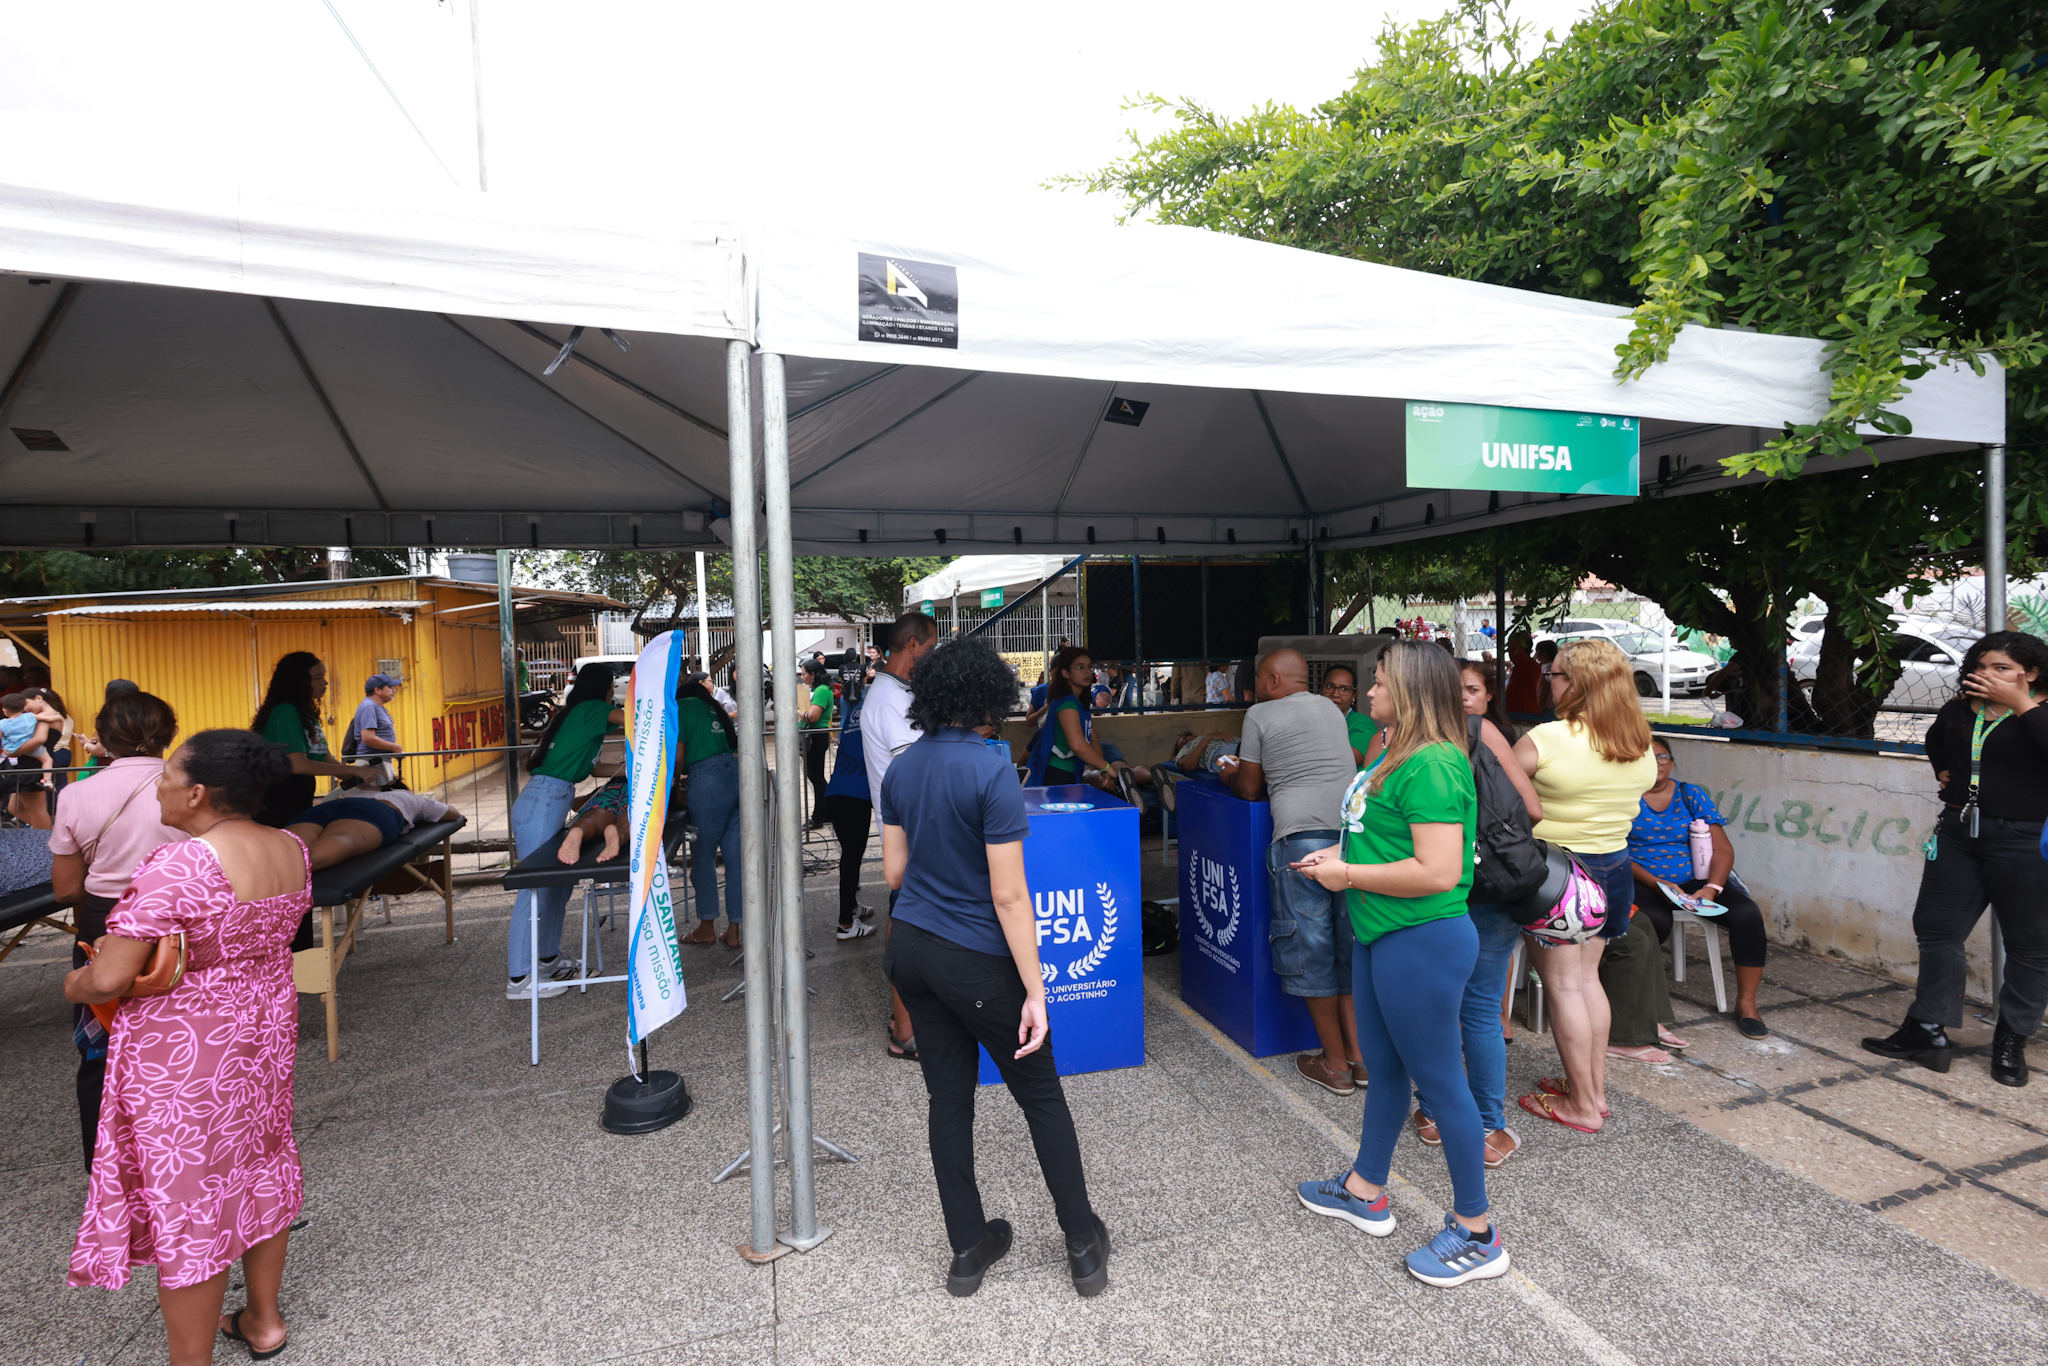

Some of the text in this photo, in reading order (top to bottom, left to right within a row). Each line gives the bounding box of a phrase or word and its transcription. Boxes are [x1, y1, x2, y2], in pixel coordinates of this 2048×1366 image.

[861, 314, 893, 322] GERADORES
[920, 319, 955, 328] SONORIZAÇÃO
[861, 320, 893, 328] ILUMINAÇÃO
[896, 322, 916, 330] TENDAS
[918, 324, 939, 332] STANDS
[1412, 405, 1445, 418] ação
[1482, 442, 1572, 471] UNIFSA
[432, 710, 477, 767] PLANET
[637, 698, 654, 756] missão
[632, 708, 667, 858] @clinica_franciscosantana
[1202, 856, 1224, 890] UNI
[1035, 888, 1085, 918] UNI
[1202, 880, 1229, 917] FSA
[656, 892, 684, 985] SANTANA
[1035, 915, 1093, 946] FSA
[1210, 943, 1241, 969] UNIVERSITÁRIO
[1212, 953, 1237, 974] AGOSTINHO
[647, 944, 672, 1000] missão
[1052, 979, 1117, 994] UNIVERSITÁRIO
[1056, 989, 1108, 1003] AGOSTINHO
